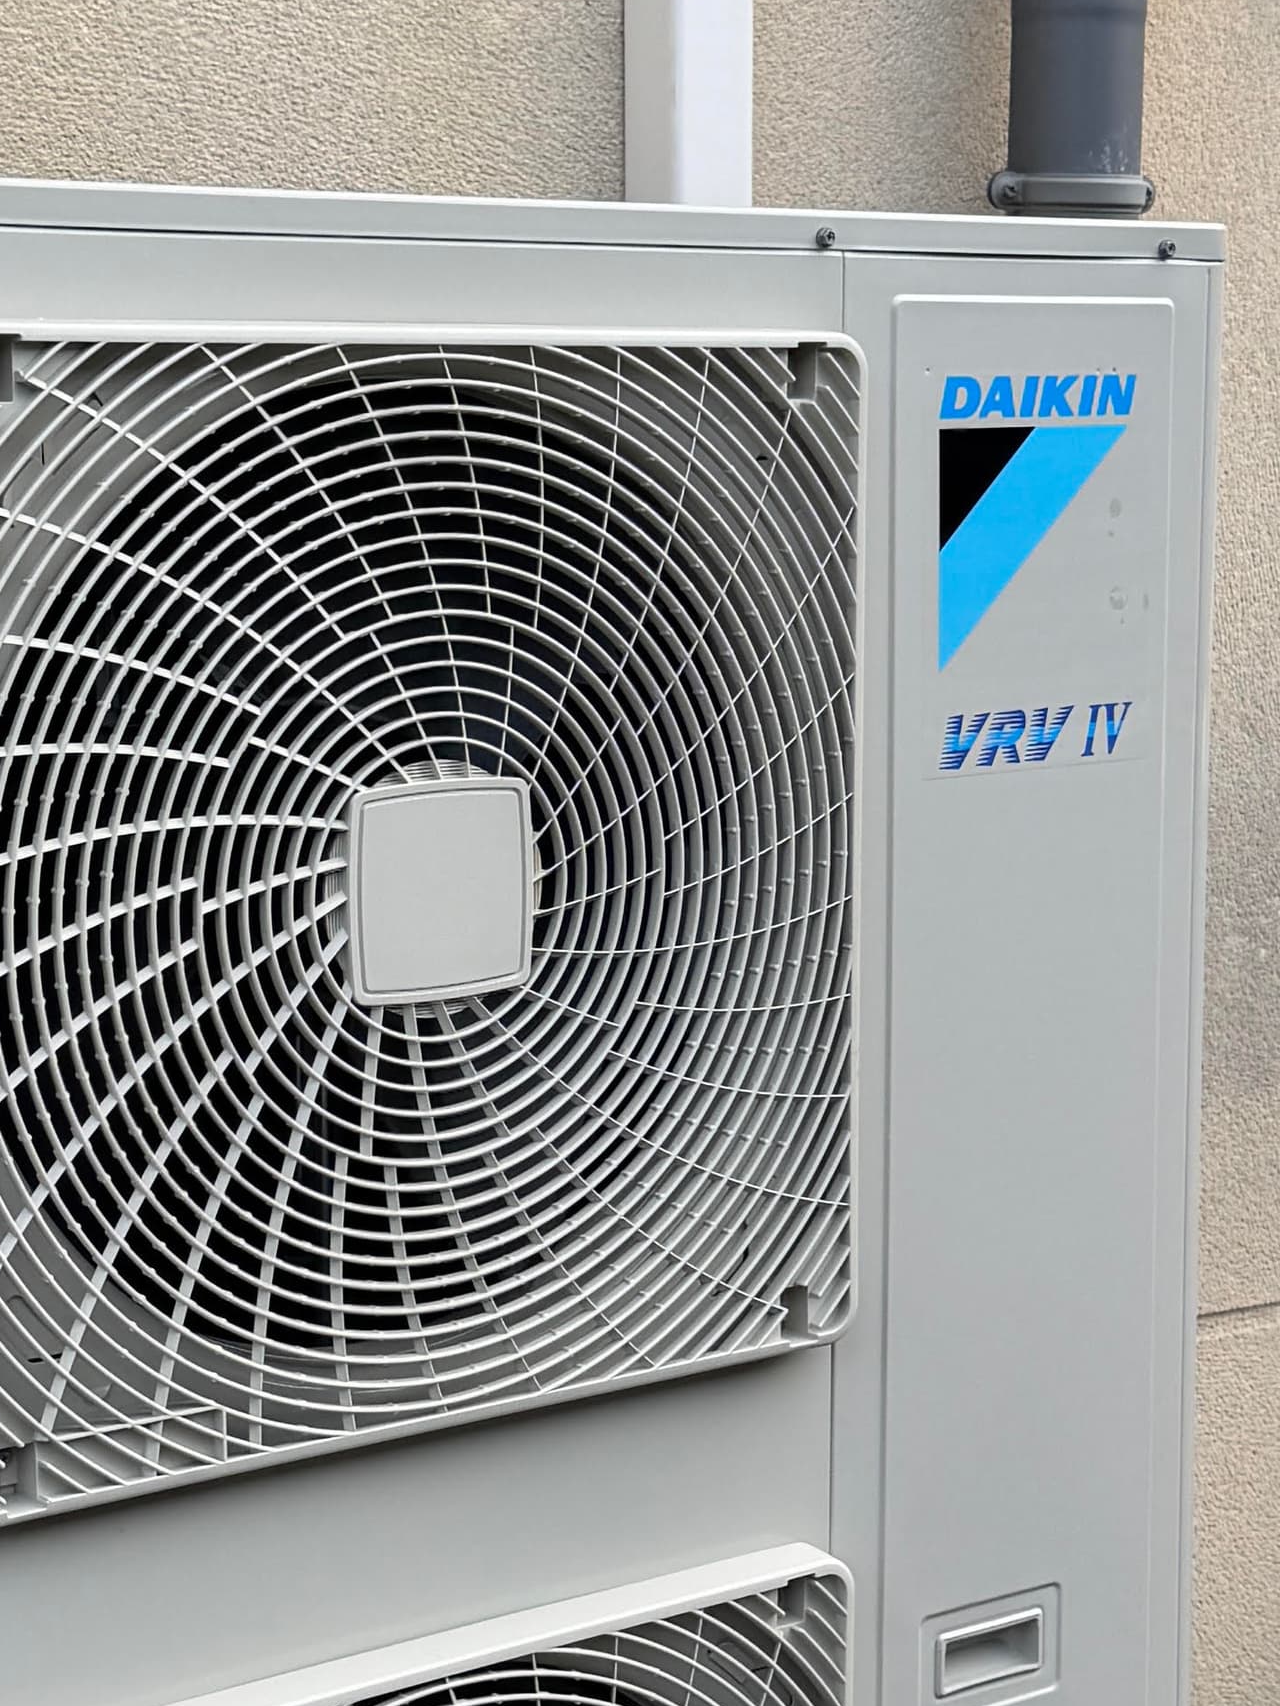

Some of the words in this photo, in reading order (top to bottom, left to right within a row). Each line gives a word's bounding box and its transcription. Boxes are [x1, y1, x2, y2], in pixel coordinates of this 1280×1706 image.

[939, 374, 1137, 420] DAIKIN
[938, 704, 1075, 771] VRV
[1080, 701, 1133, 758] IV
